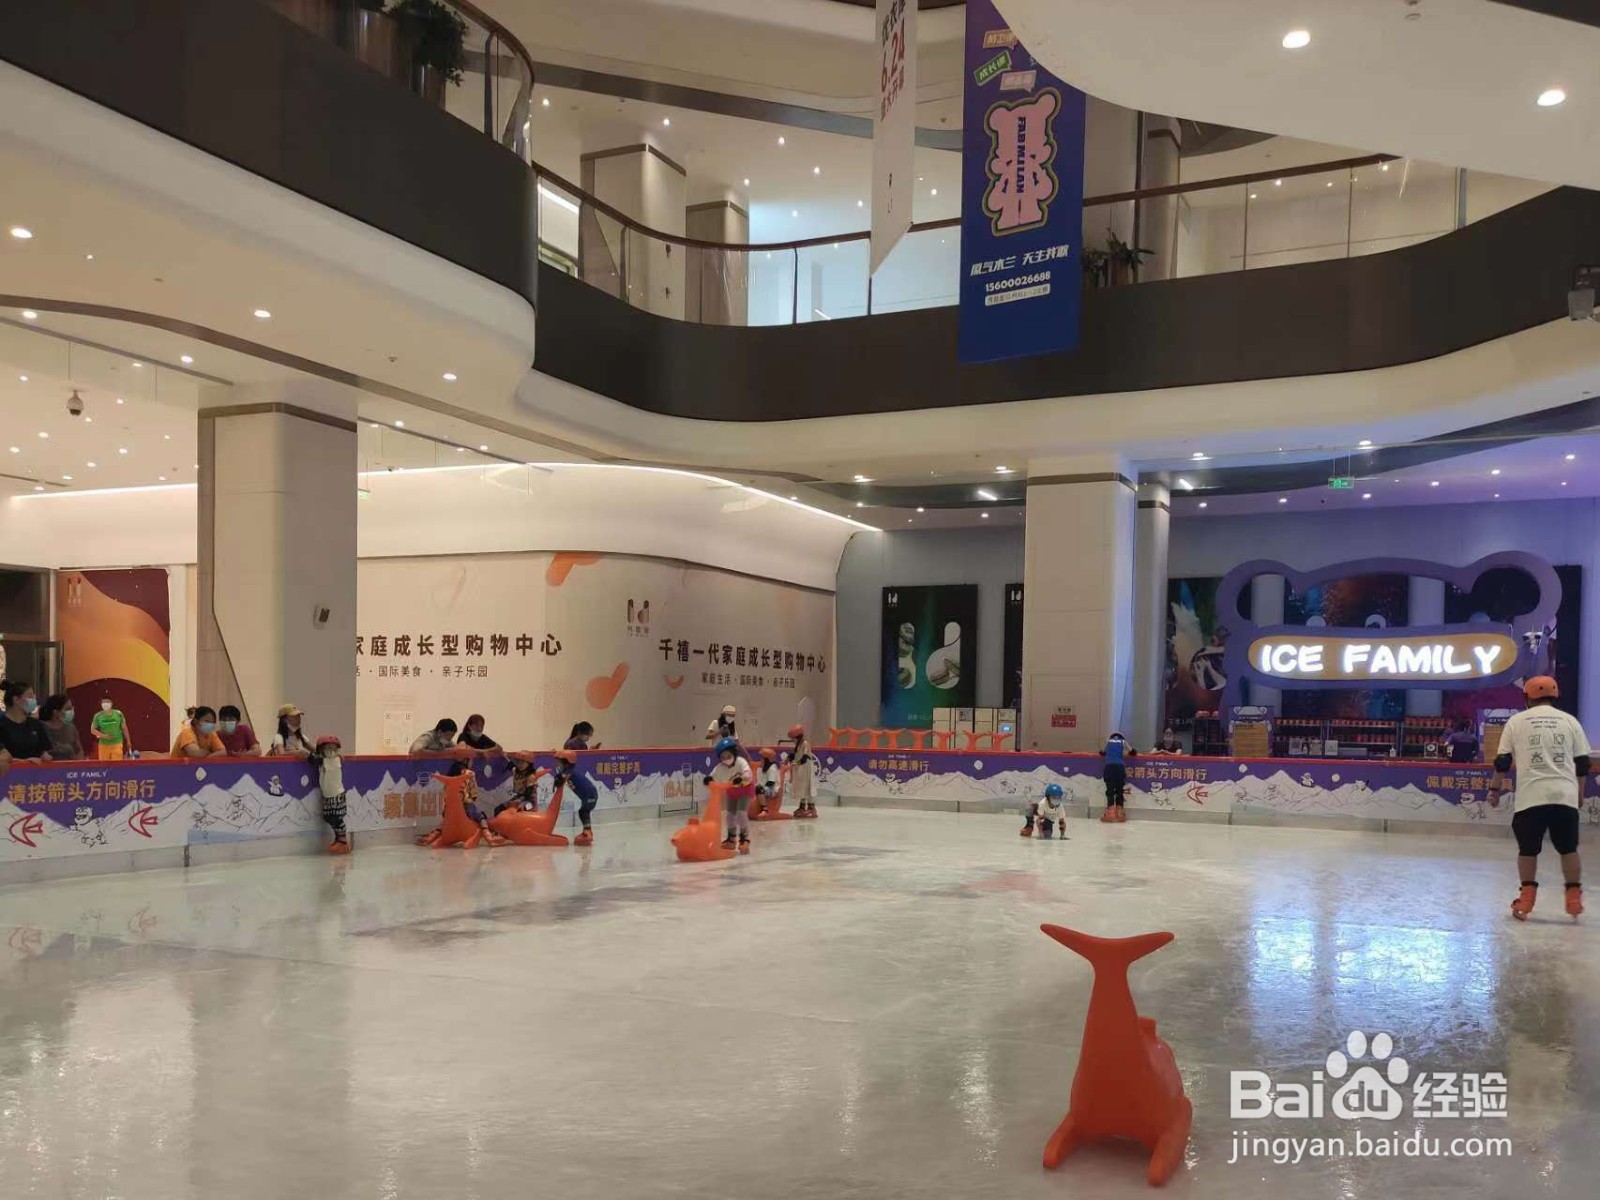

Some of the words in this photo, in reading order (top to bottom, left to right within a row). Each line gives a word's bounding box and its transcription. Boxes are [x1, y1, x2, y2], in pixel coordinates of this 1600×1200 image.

[1017, 116, 1026, 142] FAB
[1016, 145, 1026, 193] MULAN
[985, 270, 1051, 292] 15600026688
[659, 638, 826, 673] 千禧一代家庭成长型购物中心
[1262, 645, 1323, 673] ICE
[1344, 644, 1501, 674] FAMILY
[67, 771, 78, 779] ICE
[81, 769, 108, 778] FAMILY
[8, 779, 156, 804] 请按箭头方向滑行
